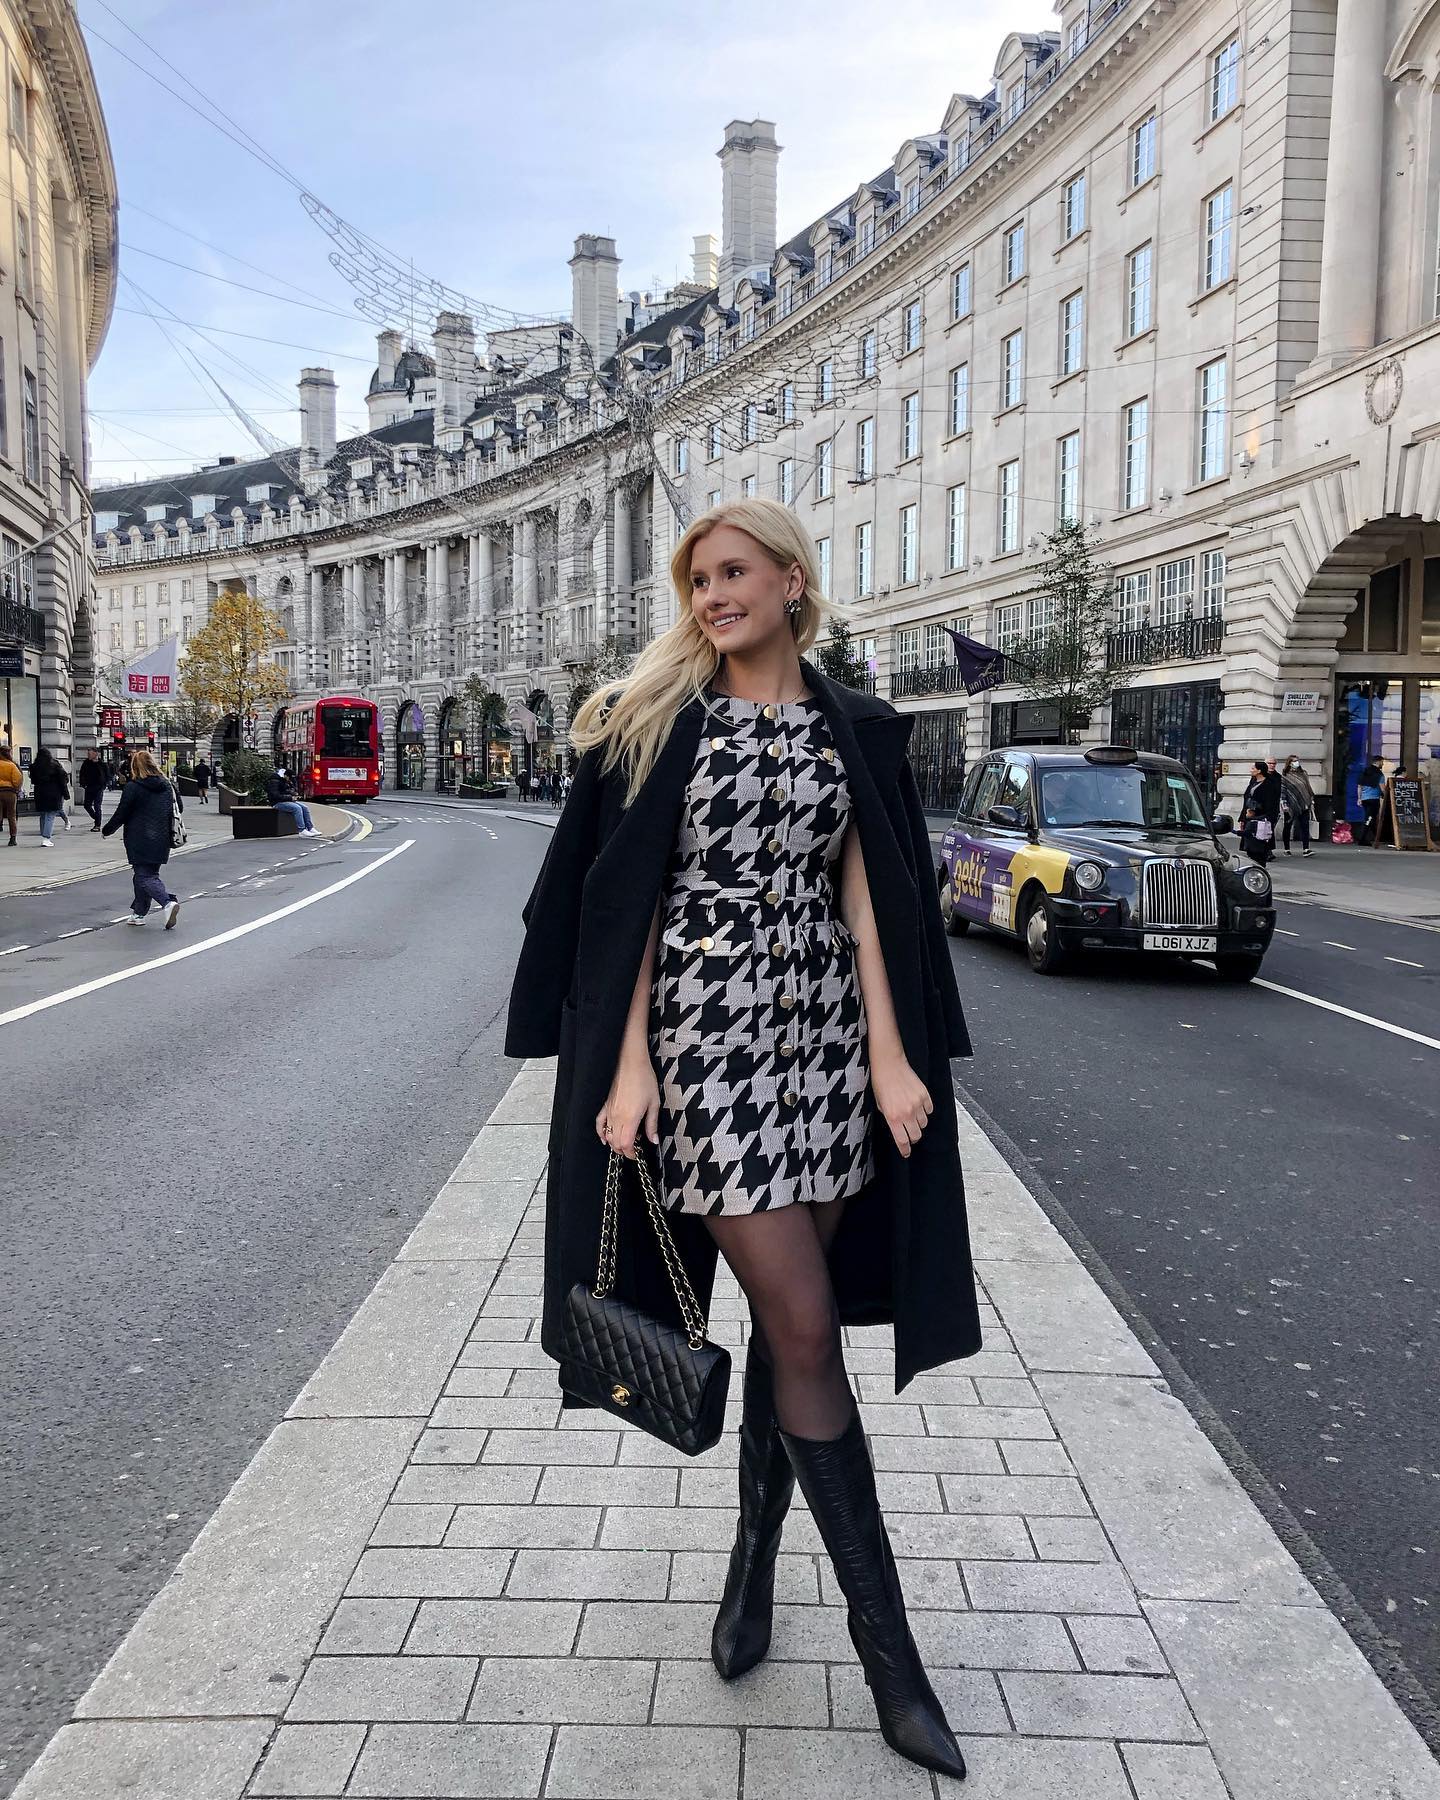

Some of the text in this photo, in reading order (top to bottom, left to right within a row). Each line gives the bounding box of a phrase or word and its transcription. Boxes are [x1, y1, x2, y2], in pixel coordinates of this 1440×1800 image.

[341, 720, 353, 728] 139
[1394, 787, 1418, 798] BEST
[1404, 807, 1413, 815] IN
[953, 851, 987, 904] getir
[1152, 936, 1210, 950] LO61 XJZ
